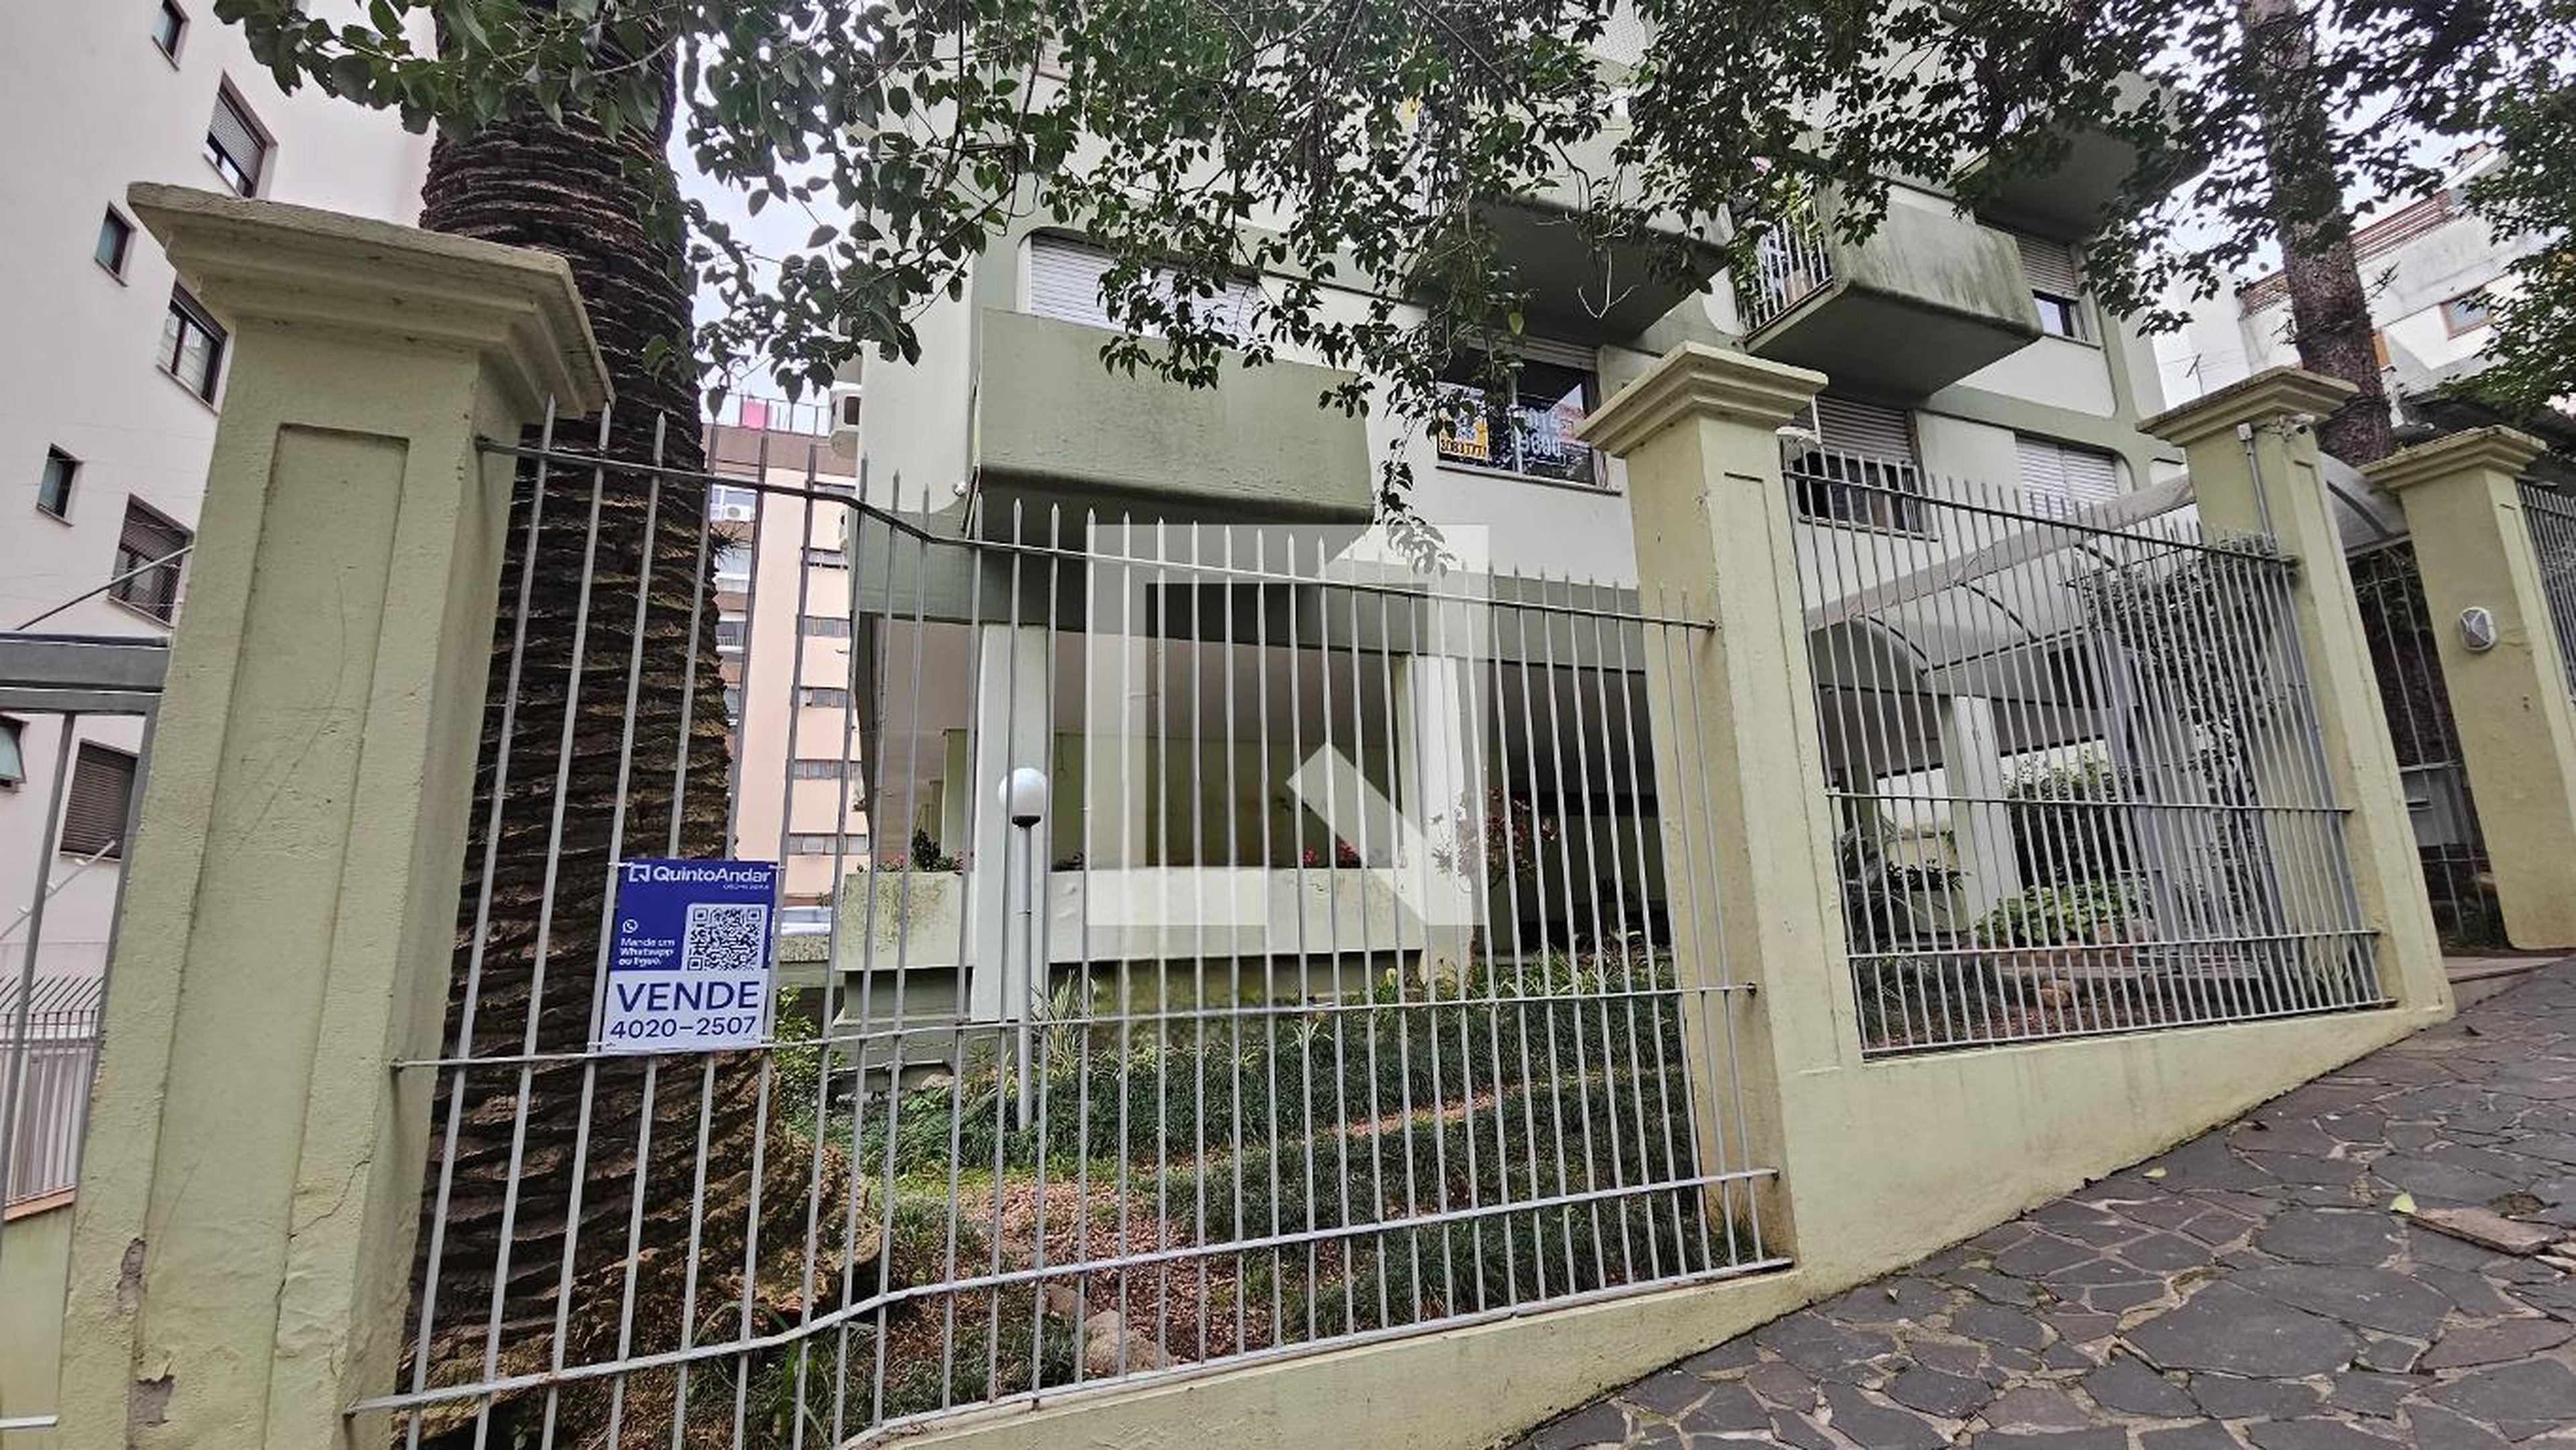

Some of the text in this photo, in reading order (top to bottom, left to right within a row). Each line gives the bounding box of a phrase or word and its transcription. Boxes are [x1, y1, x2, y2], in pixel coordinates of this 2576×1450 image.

[653, 866, 771, 883] QuintoAndar
[616, 981, 760, 1013] VENDE
[610, 1015, 757, 1039] 4020-2507
